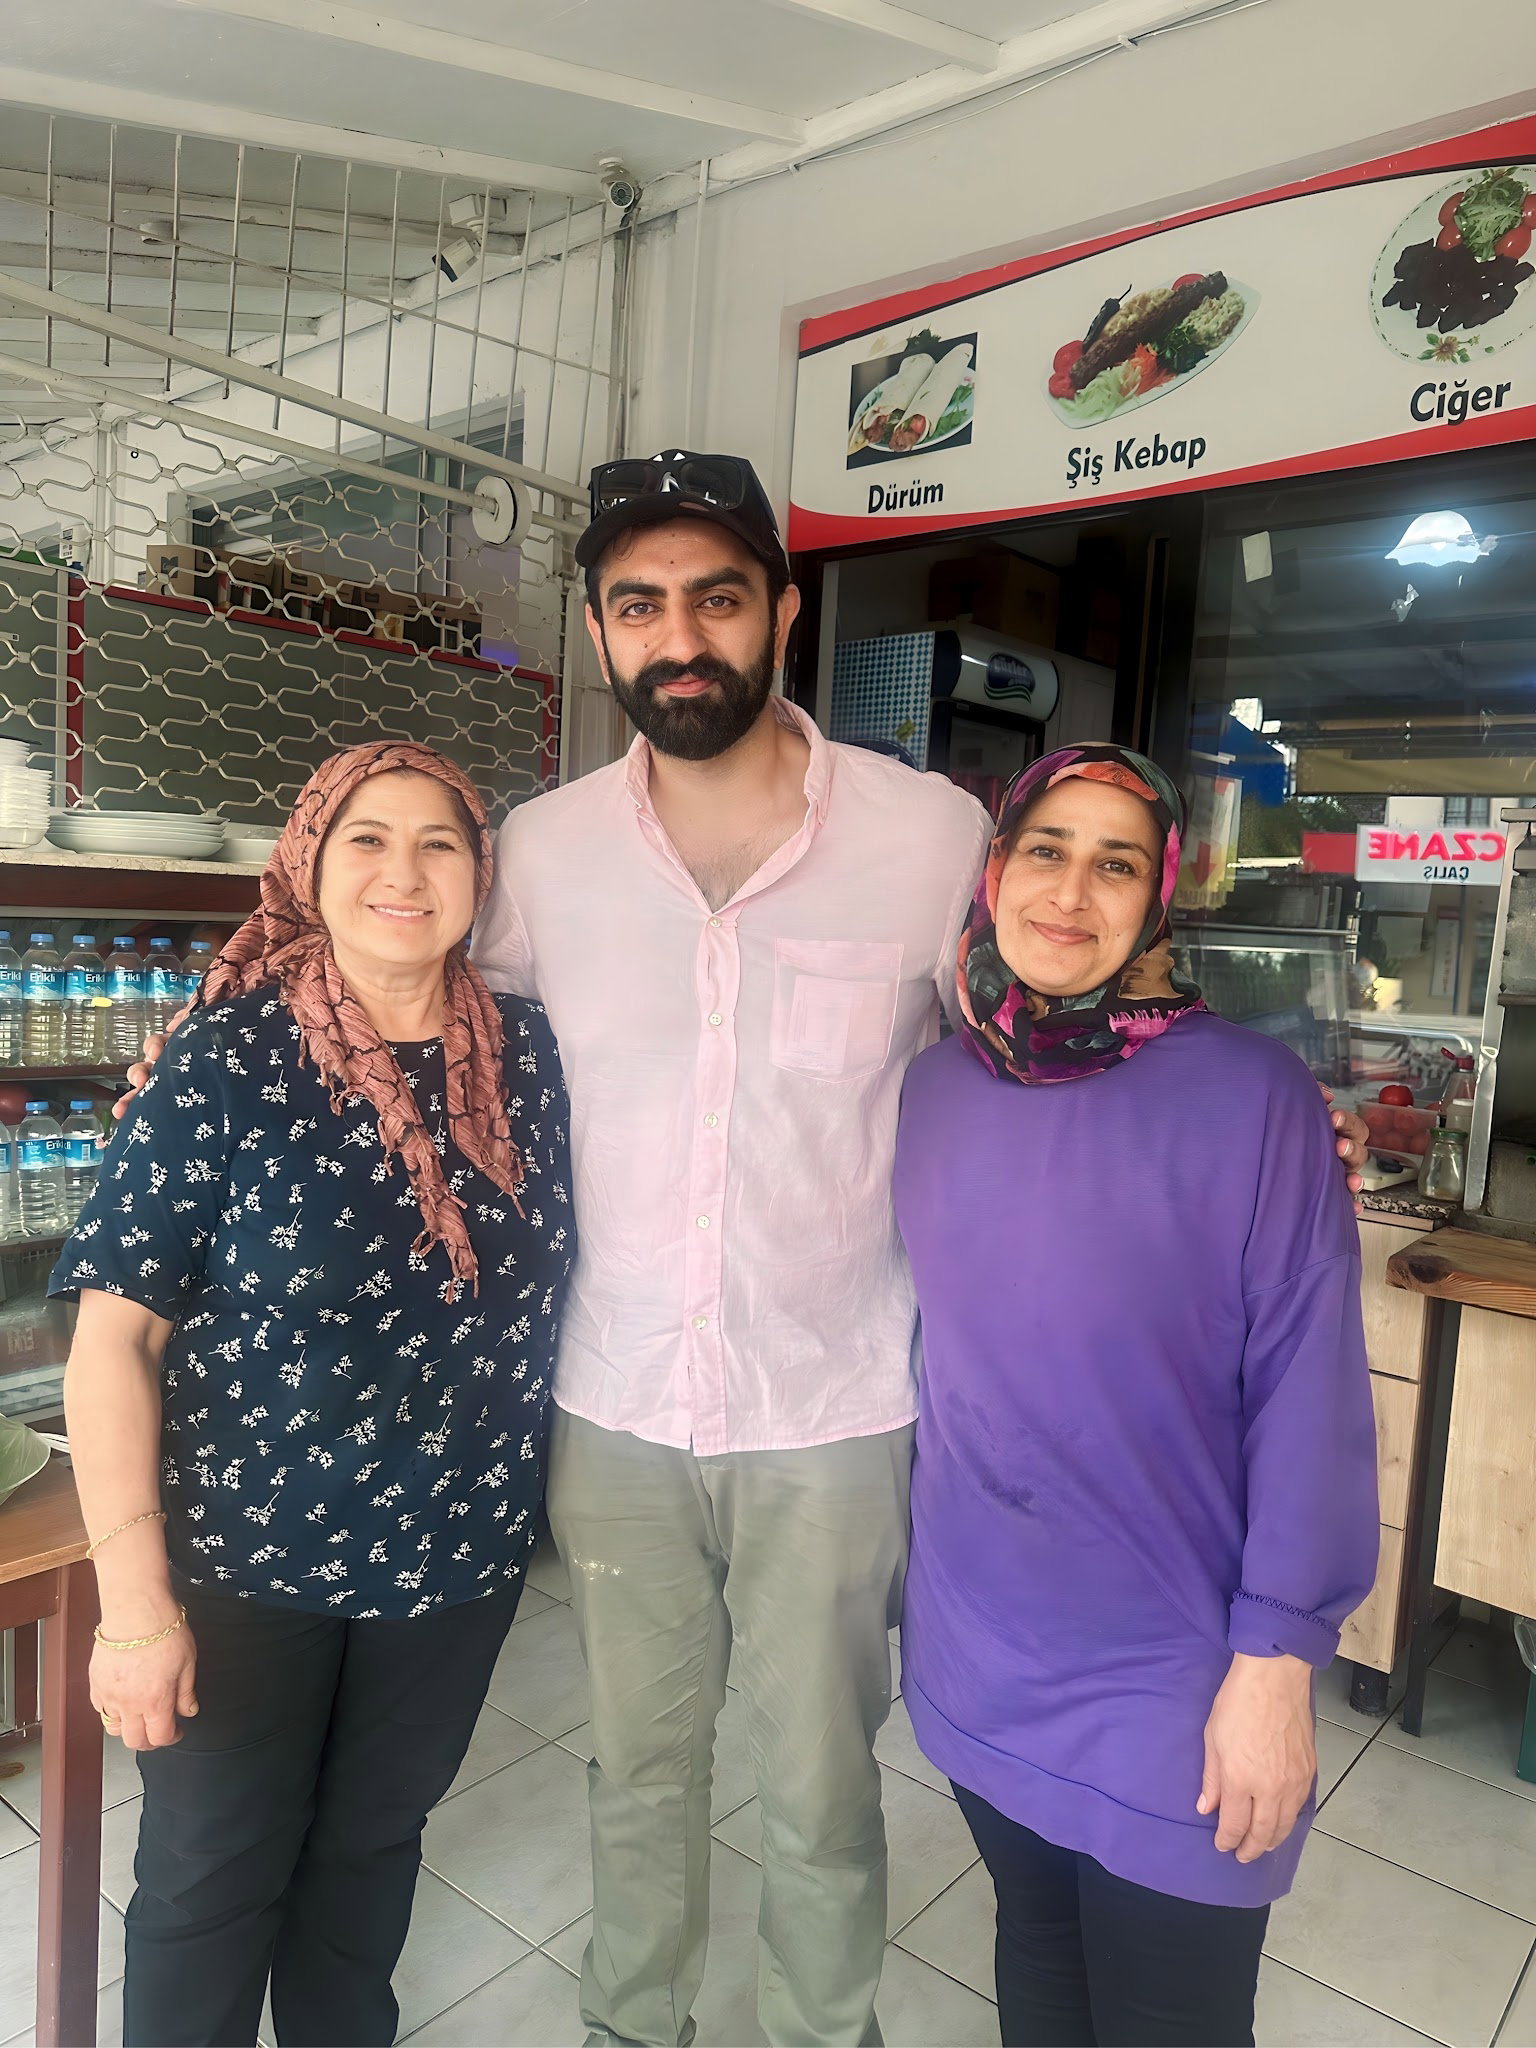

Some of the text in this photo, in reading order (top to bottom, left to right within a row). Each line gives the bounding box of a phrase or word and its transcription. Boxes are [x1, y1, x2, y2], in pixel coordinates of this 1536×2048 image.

[1410, 378, 1512, 426] Ciğer
[1066, 432, 1207, 489] Şiş Kebap
[867, 479, 944, 514] Dürüm
[30, 972, 56, 982] Erikli
[116, 973, 141, 982] Erikli
